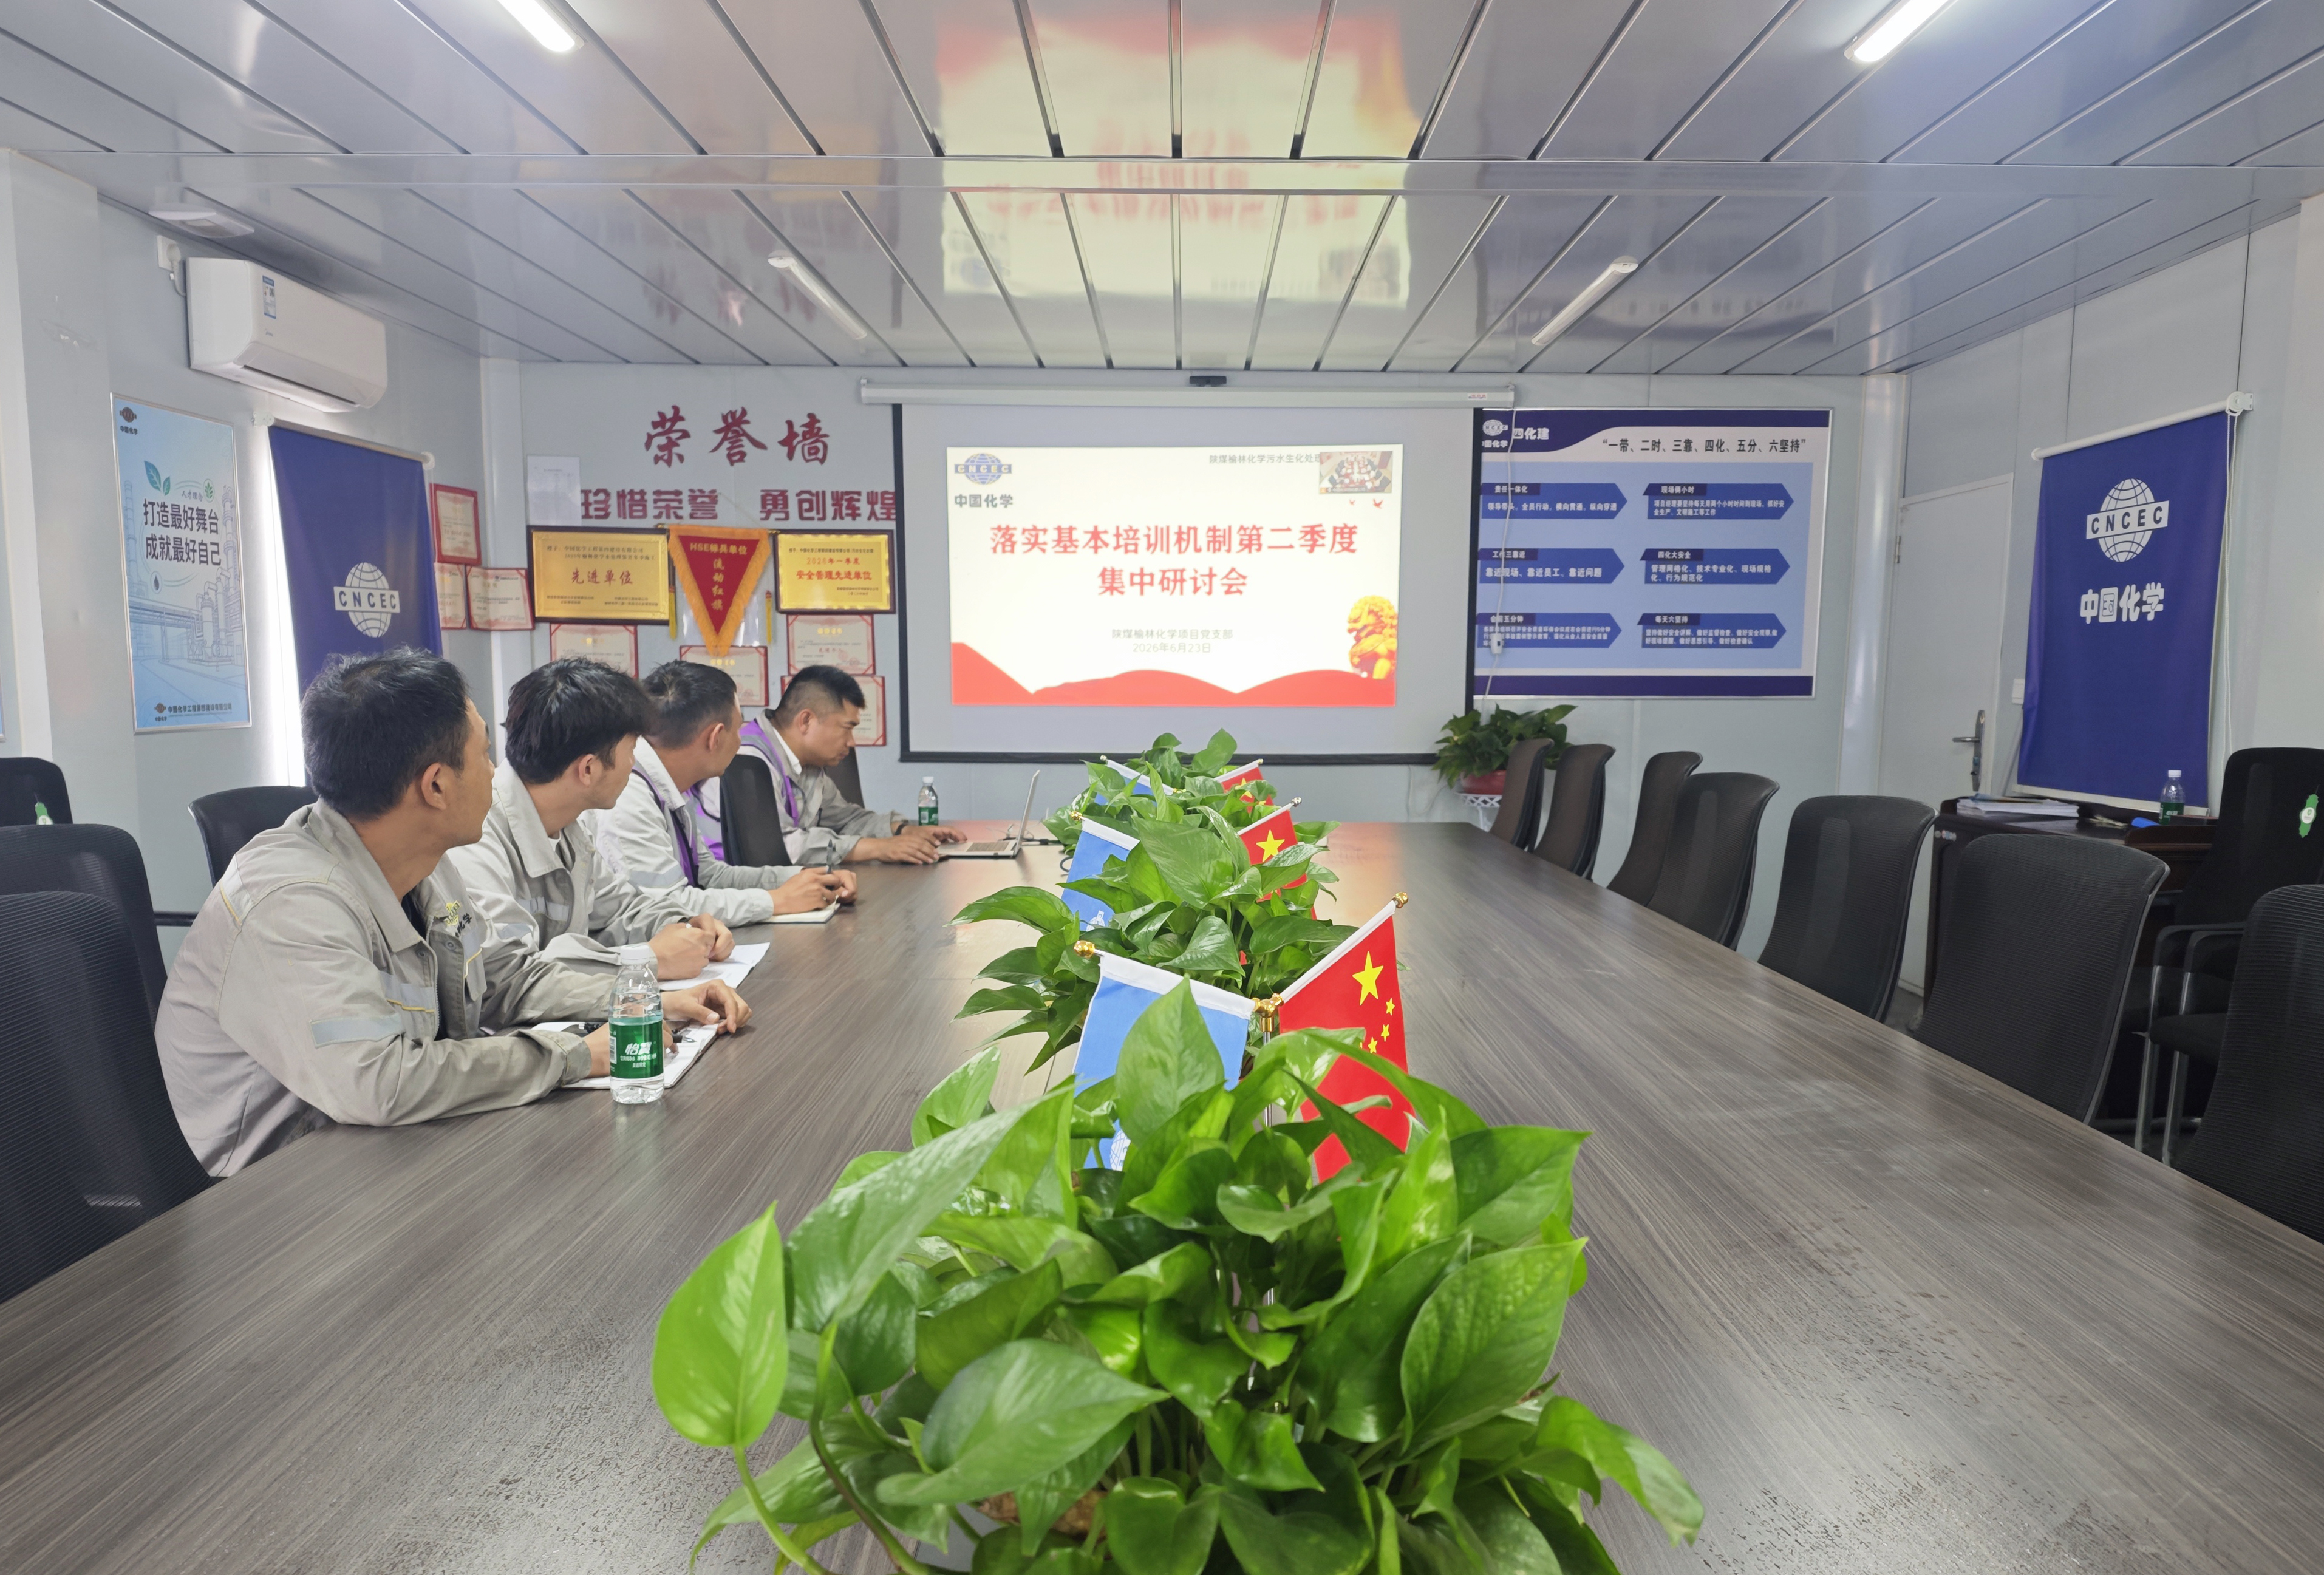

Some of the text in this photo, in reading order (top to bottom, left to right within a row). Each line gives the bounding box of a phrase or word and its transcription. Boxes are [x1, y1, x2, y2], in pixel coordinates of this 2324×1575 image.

[644, 405, 830, 468] 荣誉墙
[1513, 428, 1549, 440] 四化建
[581, 488, 896, 521] 珍惜荣誉 勇创辉煌
[955, 494, 1013, 508] 中国化学
[143, 498, 219, 535] 打造最好舞台
[2091, 506, 2163, 534] CNCEC
[146, 533, 222, 566] 成就最好自己
[990, 523, 1358, 555] 落实基本培训机制第二季度
[571, 568, 633, 585] 先进单位
[1097, 566, 1248, 596] 集中研讨会
[339, 591, 396, 610] CNCEC
[2080, 582, 2164, 624] 中国化学
[1112, 628, 1233, 639] 陕煤榆林化学项目党支部
[1133, 642, 1211, 653] 2026年6月23日
